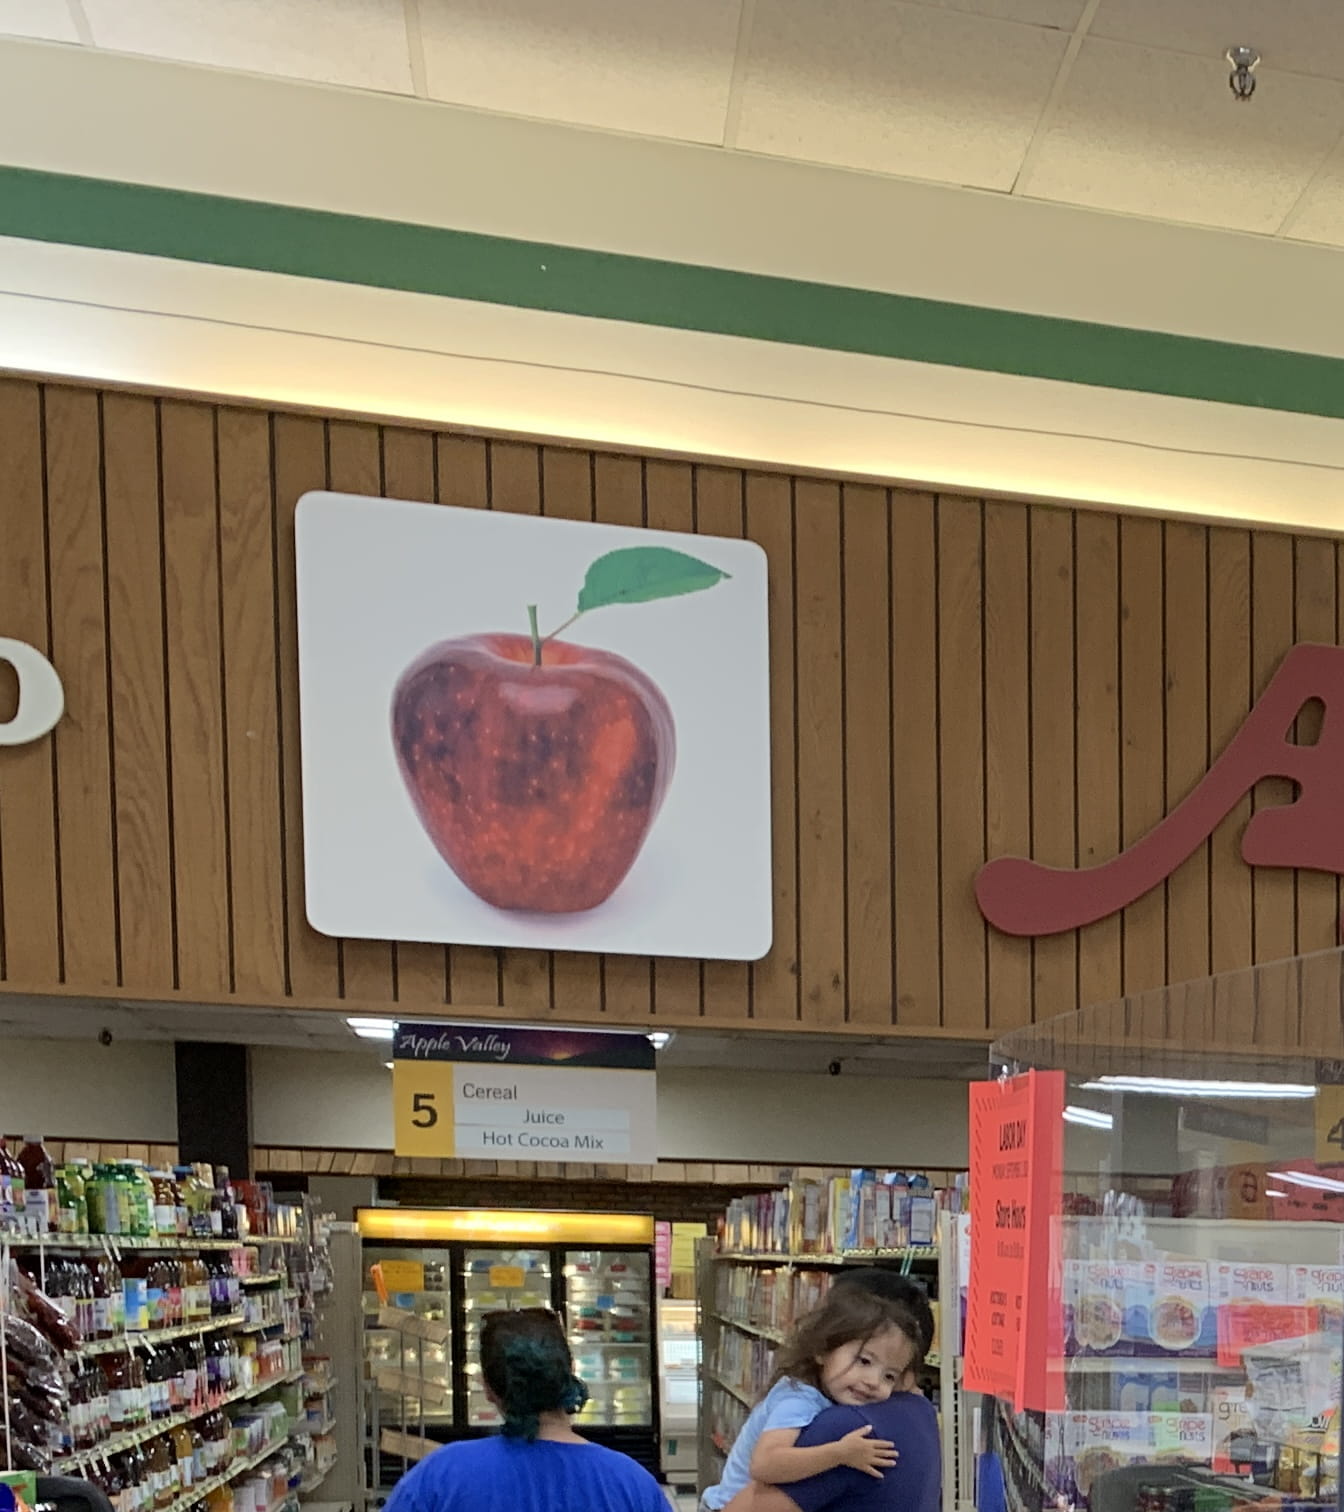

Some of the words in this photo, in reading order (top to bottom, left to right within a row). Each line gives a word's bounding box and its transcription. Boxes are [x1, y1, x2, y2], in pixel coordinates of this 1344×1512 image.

[400, 1033, 450, 1057] Apple
[455, 1034, 511, 1061] Valley
[463, 1082, 517, 1100] Cereal
[412, 1093, 438, 1128] 5
[523, 1109, 565, 1125] Juice
[483, 1132, 513, 1147] Hot
[517, 1132, 569, 1148] Cocoa
[574, 1135, 604, 1150] Mix
